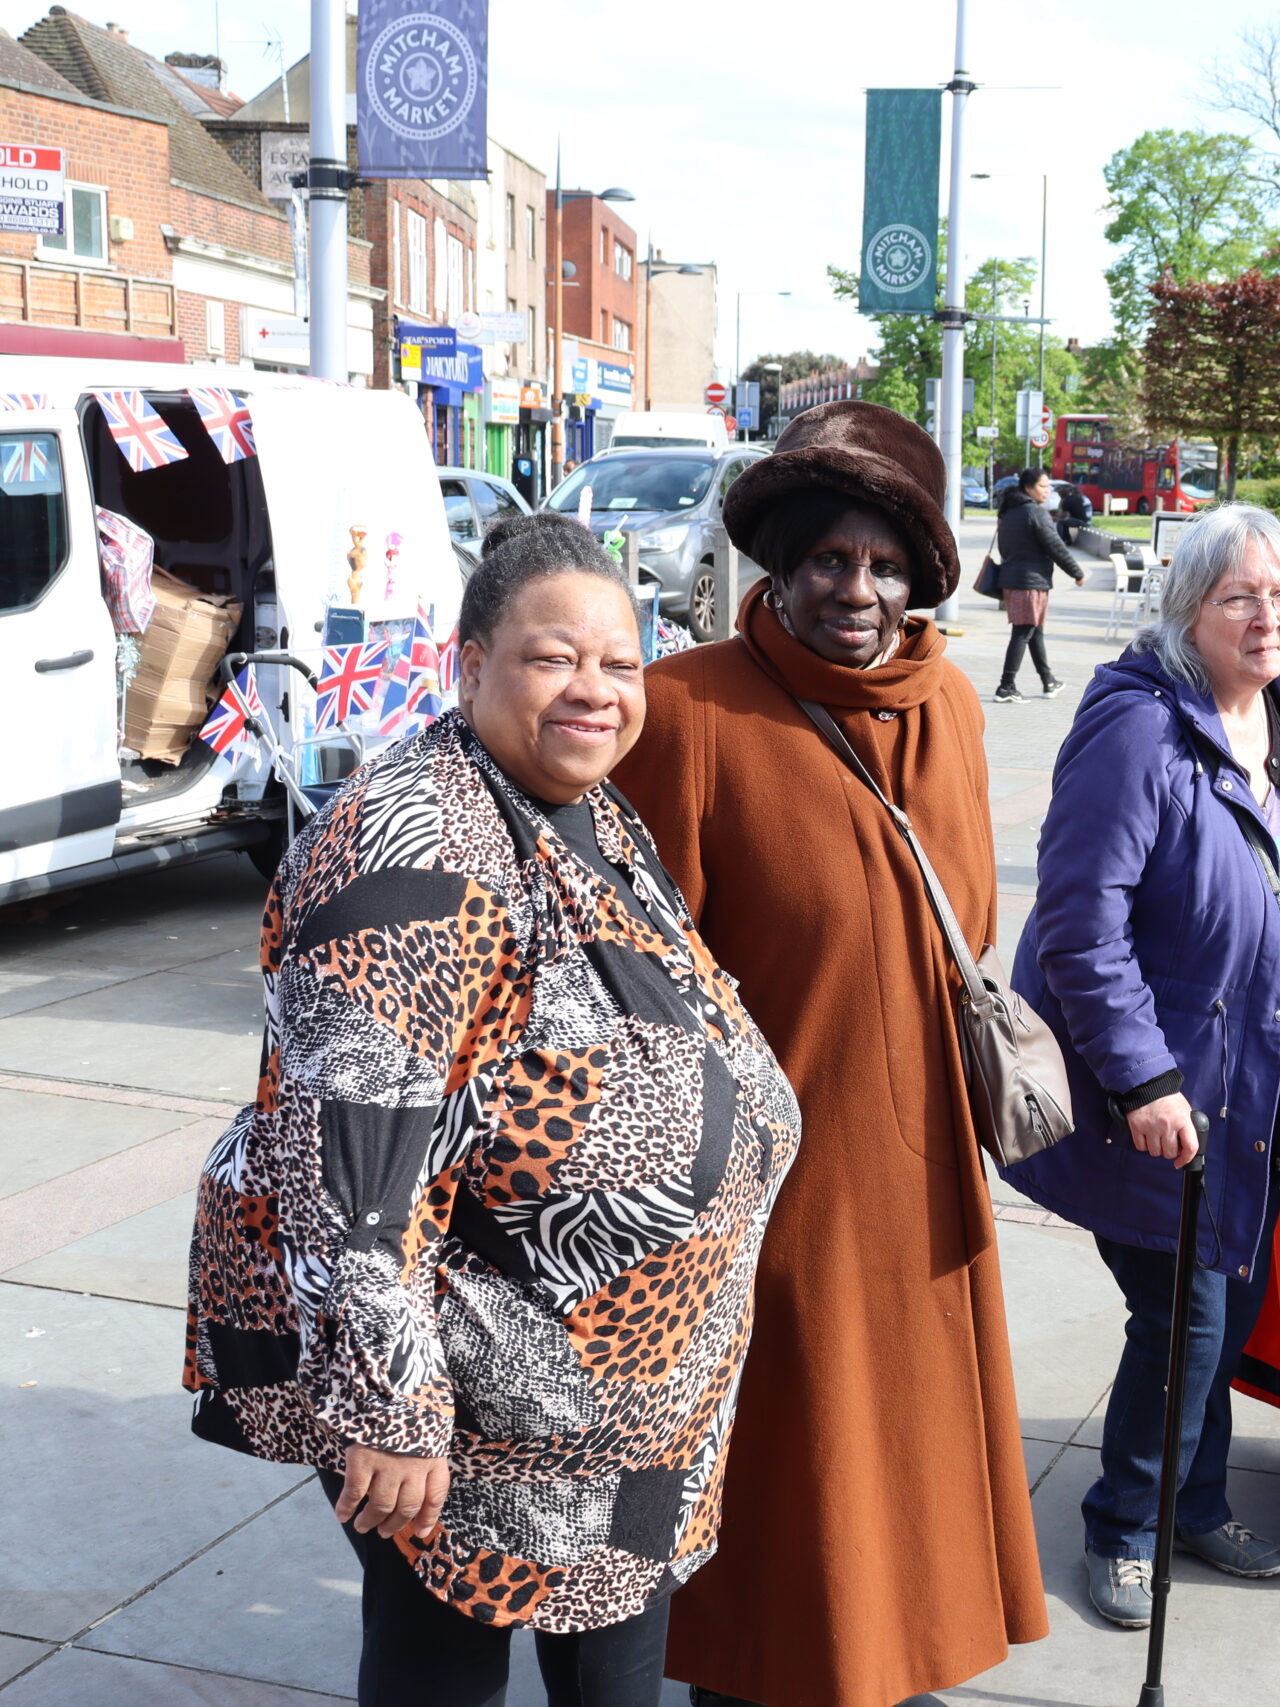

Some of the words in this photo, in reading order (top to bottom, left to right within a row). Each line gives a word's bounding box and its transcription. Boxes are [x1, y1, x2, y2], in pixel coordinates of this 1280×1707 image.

[380, 29, 463, 75] MITCHAM
[383, 87, 457, 124] MARKET
[24, 198, 58, 209] STUART
[875, 233, 923, 258] MITCHAM
[876, 264, 919, 285] MARKET
